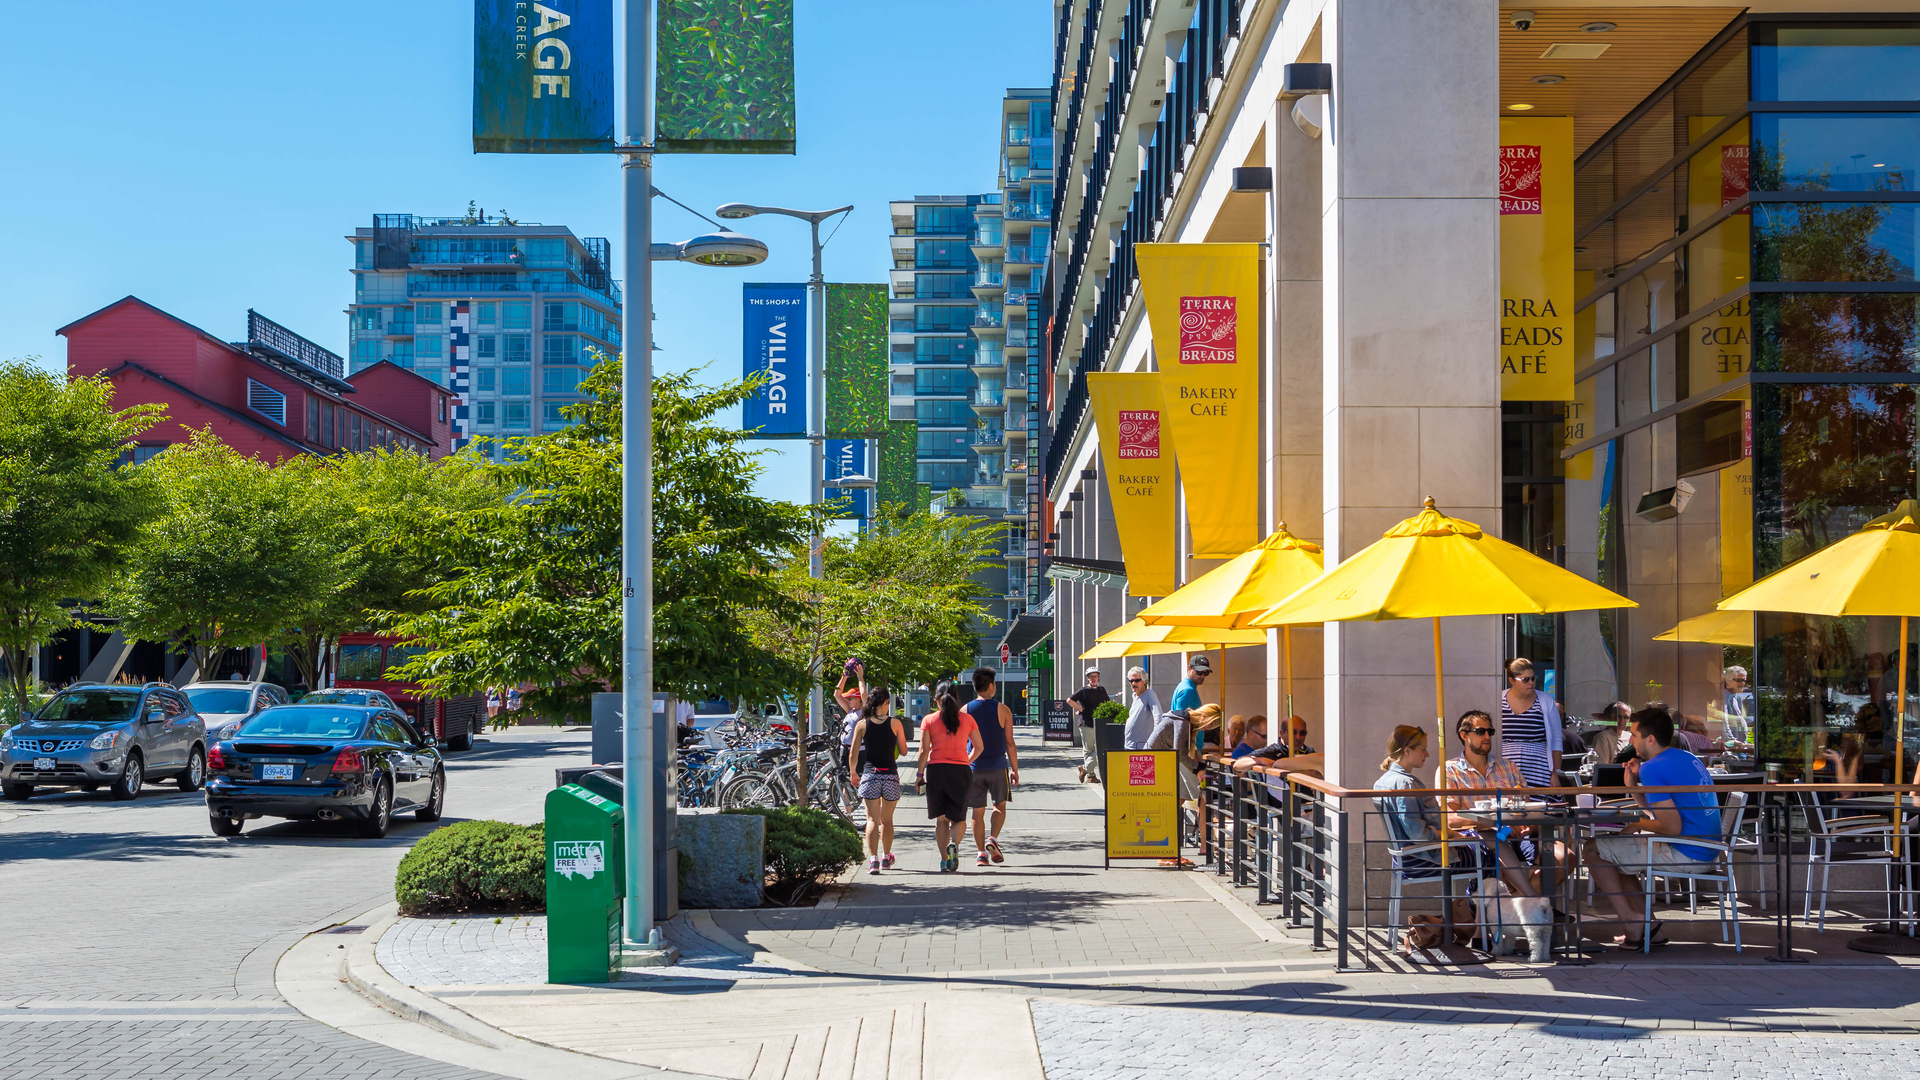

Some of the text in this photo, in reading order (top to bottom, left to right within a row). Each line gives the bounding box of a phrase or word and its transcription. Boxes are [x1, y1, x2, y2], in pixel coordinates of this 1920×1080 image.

[516, 15, 527, 60] CREEK
[533, 0, 571, 98] AGE
[1184, 299, 1232, 310] TERRA
[761, 339, 767, 350] ON
[1181, 350, 1235, 362] BREADS
[768, 322, 787, 415] VILLAGE
[1180, 386, 1238, 399] BAKERY
[1190, 402, 1228, 416] CAFÉ
[1122, 412, 1156, 420] TERRA
[1120, 448, 1159, 457] BREADS
[841, 444, 853, 503] VILLGE
[1119, 474, 1160, 484] BAKERY
[1126, 486, 1153, 496] CAFÉ
[558, 844, 598, 857] metr
